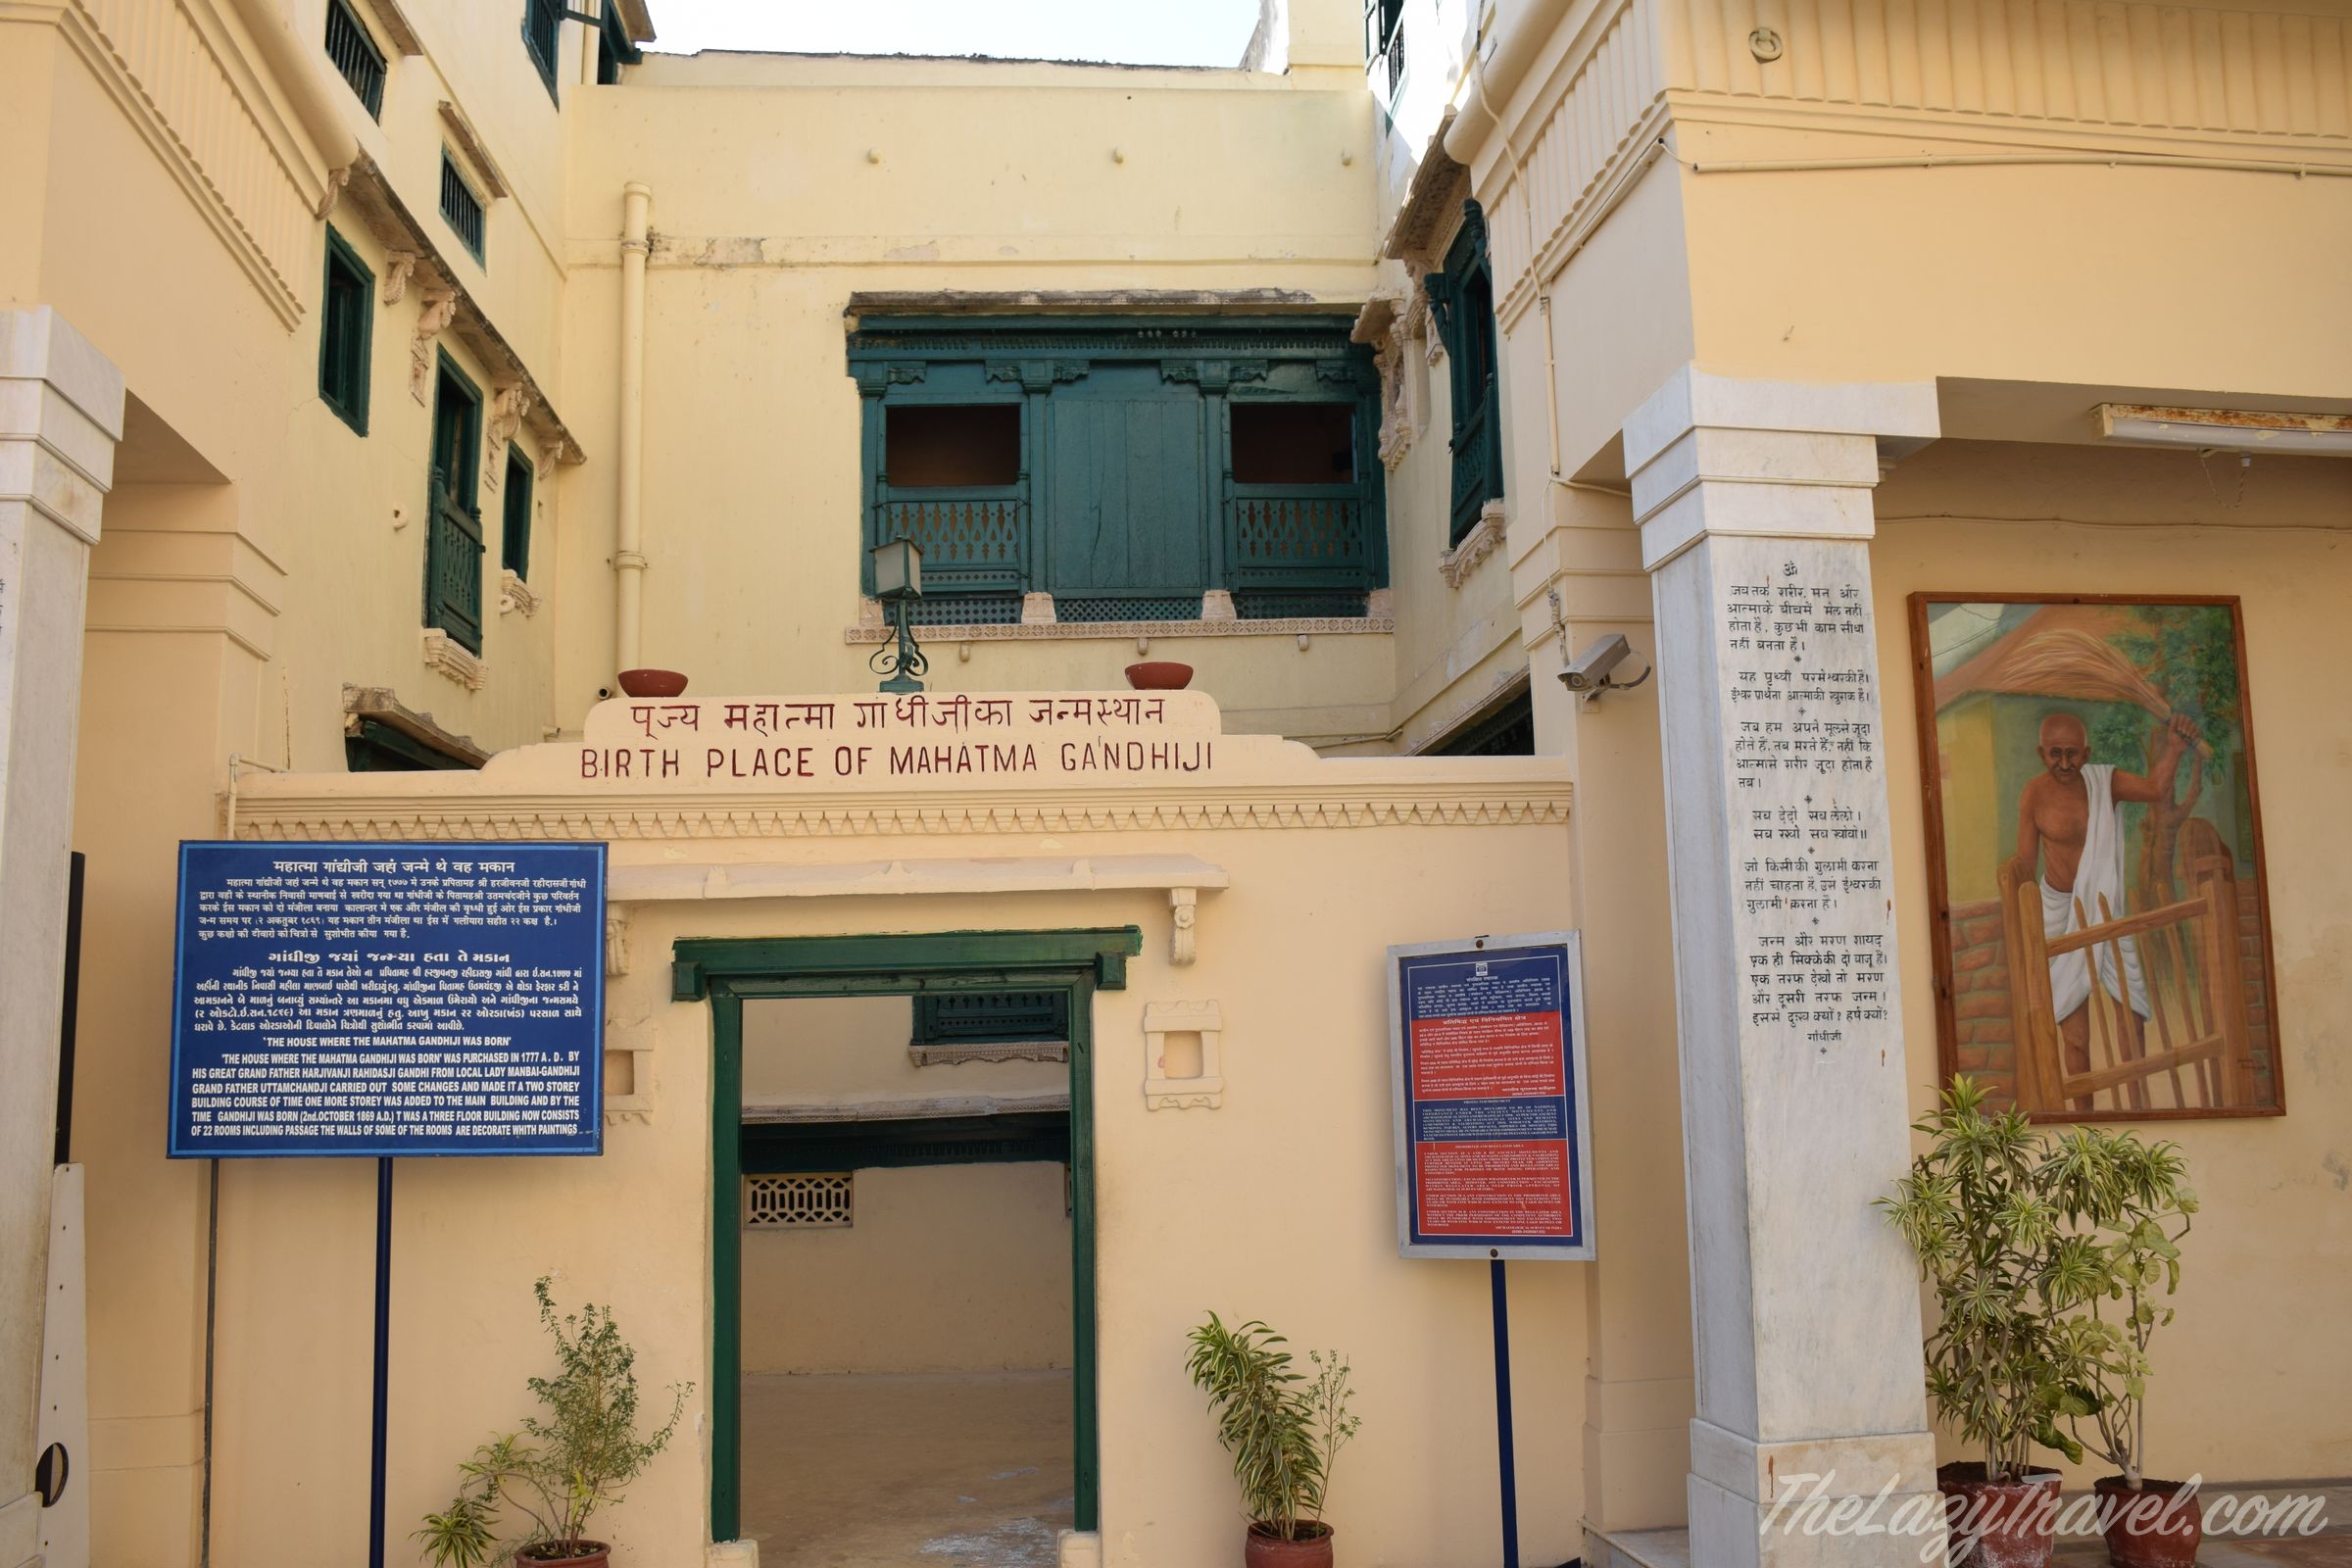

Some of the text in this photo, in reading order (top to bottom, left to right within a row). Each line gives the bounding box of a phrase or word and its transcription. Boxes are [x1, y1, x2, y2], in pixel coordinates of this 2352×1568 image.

[1727, 601, 1773, 613] आत्माके
[1823, 602, 1840, 615] मेल
[1843, 603, 1861, 615] नहीं
[630, 706, 700, 740] पूज्य
[724, 703, 834, 736] महात्मा
[1029, 699, 1164, 727] जन्मस्थान
[582, 743, 1210, 777] BIRTH PLACE OF MAHATMA GANDHIJI
[272, 861, 318, 872] महात्मा
[401, 858, 429, 872] जन्मे
[435, 858, 447, 872] थे
[452, 861, 472, 873] वह
[477, 861, 514, 872] मकान
[1744, 858, 1758, 871] जो
[1815, 858, 1846, 875] गुलामी
[1851, 860, 1879, 870] करना
[1758, 932, 1883, 947] जन्म और मरण शायद
[269, 950, 319, 963] ગાંધીજી
[423, 952, 449, 961] હતા
[458, 950, 467, 961] તે
[472, 954, 509, 962] મકાન
[1749, 956, 1767, 967] एक
[1772, 952, 1783, 965] ही
[1841, 950, 1850, 966] दो
[1750, 974, 1769, 986] एक
[1777, 973, 1804, 983] तरफ
[1836, 968, 1847, 982] तो
[1856, 972, 1884, 982] मरण
[1752, 990, 1770, 1004] और
[1778, 989, 1805, 1007] दूसरी
[1815, 992, 1841, 1003] तरफ
[287, 1037, 317, 1046] HOUSE
[319, 1037, 350, 1046] WHERE
[353, 1037, 369, 1046] THE
[372, 1036, 416, 1045] MAHATMA
[418, 1036, 460, 1045] GANDHIJI
[463, 1036, 481, 1045] WAS
[1807, 1030, 1841, 1040] गांधीजी
[242, 1054, 269, 1063] HOUSE
[270, 1054, 298, 1063] WHERE
[301, 1054, 317, 1063] THE
[318, 1054, 357, 1063] MAHATMA
[359, 1053, 396, 1063] GANDHIJI
[398, 1053, 416, 1063] WAS
[444, 1053, 461, 1063] WAS
[463, 1053, 509, 1062] PURCHASED
[511, 1053, 518, 1061] IN
[521, 1052, 539, 1061] 1777
[568, 1051, 579, 1060] BY
[192, 1065, 579, 1078] HIS GREAT GRAND FATHER HARJIVANJI RAHIDASJI GANDHI FROM LOCAL LADY MANBAI-GANDHIJI
[192, 1081, 579, 1093] GRAND FATHER UTTAMCHANDJI CARRIED OUT SOME CHANGES AND MADE IT A TWO STOREY
[192, 1095, 579, 1106] BUILDING COURSE OF TIME ONE MORE STOREY WAS ADDED TO THE MAIN BUILDING AND BY THE
[192, 1111, 211, 1121] TIME
[218, 1111, 255, 1121] GANDHIJI
[257, 1110, 273, 1121] WAS
[276, 1111, 298, 1121] BORN
[357, 1110, 374, 1121] 1869
[396, 1110, 401, 1120] T
[403, 1110, 419, 1121] WAS
[421, 1111, 427, 1120] A
[429, 1110, 454, 1121] THREE
[456, 1110, 481, 1121] FLOOR
[483, 1110, 519, 1120] BUILDING
[521, 1110, 539, 1120] NOW
[541, 1109, 579, 1120] CONSISTS
[191, 1124, 577, 1135] OF 22 ROOMS INCLUDING PASSAGE THE WALLS OF SOME OF THE ROOMS ARE DECORATE WHITH PAINTINGS
